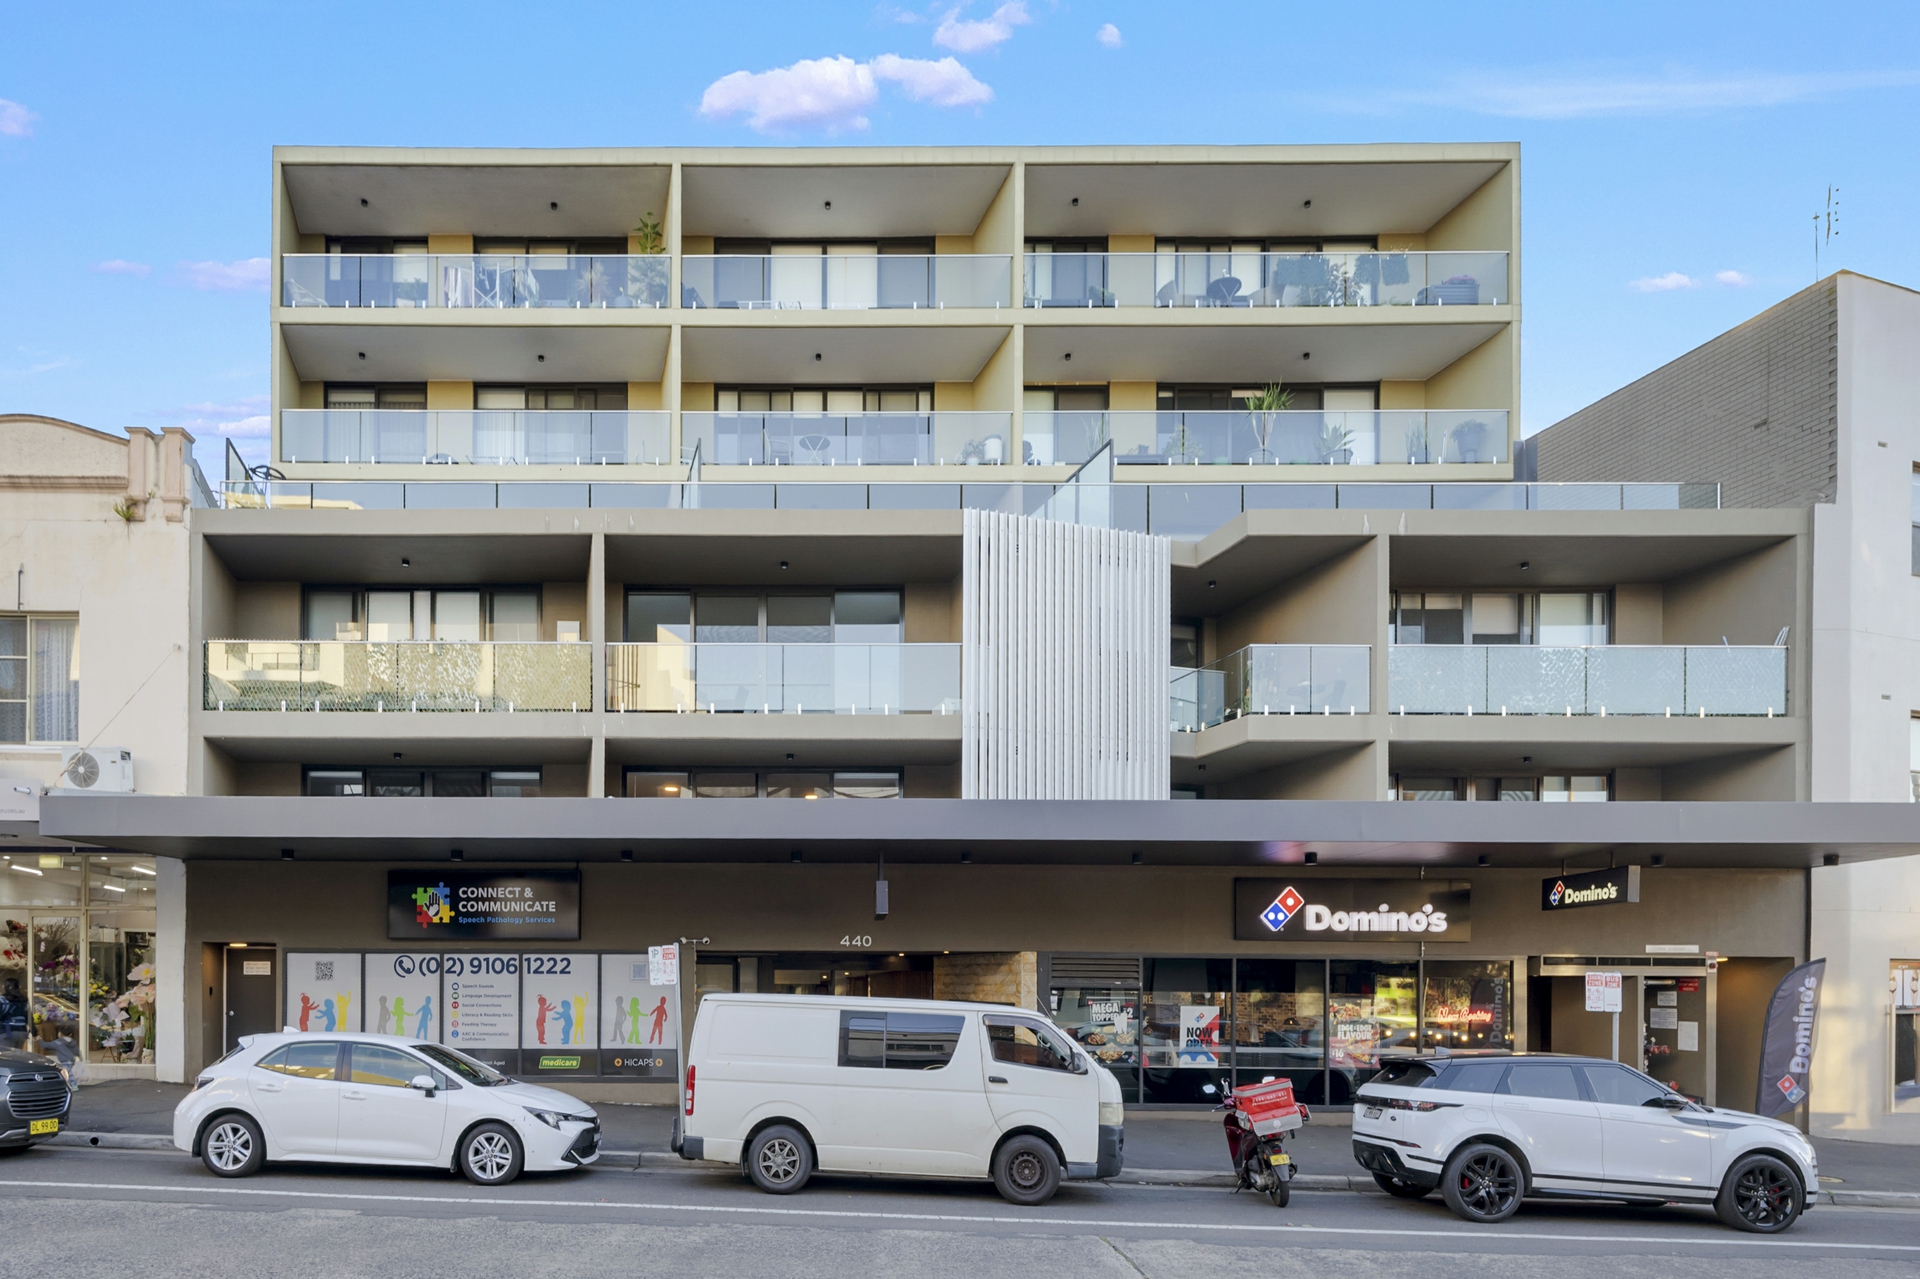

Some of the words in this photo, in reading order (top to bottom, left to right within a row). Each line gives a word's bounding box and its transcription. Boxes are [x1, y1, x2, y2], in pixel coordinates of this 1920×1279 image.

[458, 887, 521, 898] CONNECT
[524, 887, 534, 898] &
[1564, 882, 1617, 904] Domino's
[458, 901, 556, 912] COMMUNICATE
[458, 916, 485, 924] Speech
[487, 916, 523, 924] Pathology
[1304, 903, 1448, 933] Domino's
[840, 935, 872, 947] 440
[418, 957, 464, 977] (02)
[469, 957, 518, 975] 9106
[524, 957, 572, 975] 1222
[1092, 1002, 1119, 1014] MEGA
[1437, 1007, 1459, 1023] Now
[1460, 1007, 1492, 1022] Cooking
[1788, 976, 1817, 1074] Domino's
[1187, 1027, 1213, 1038] NOW
[1338, 1032, 1372, 1040] FLAVOUR
